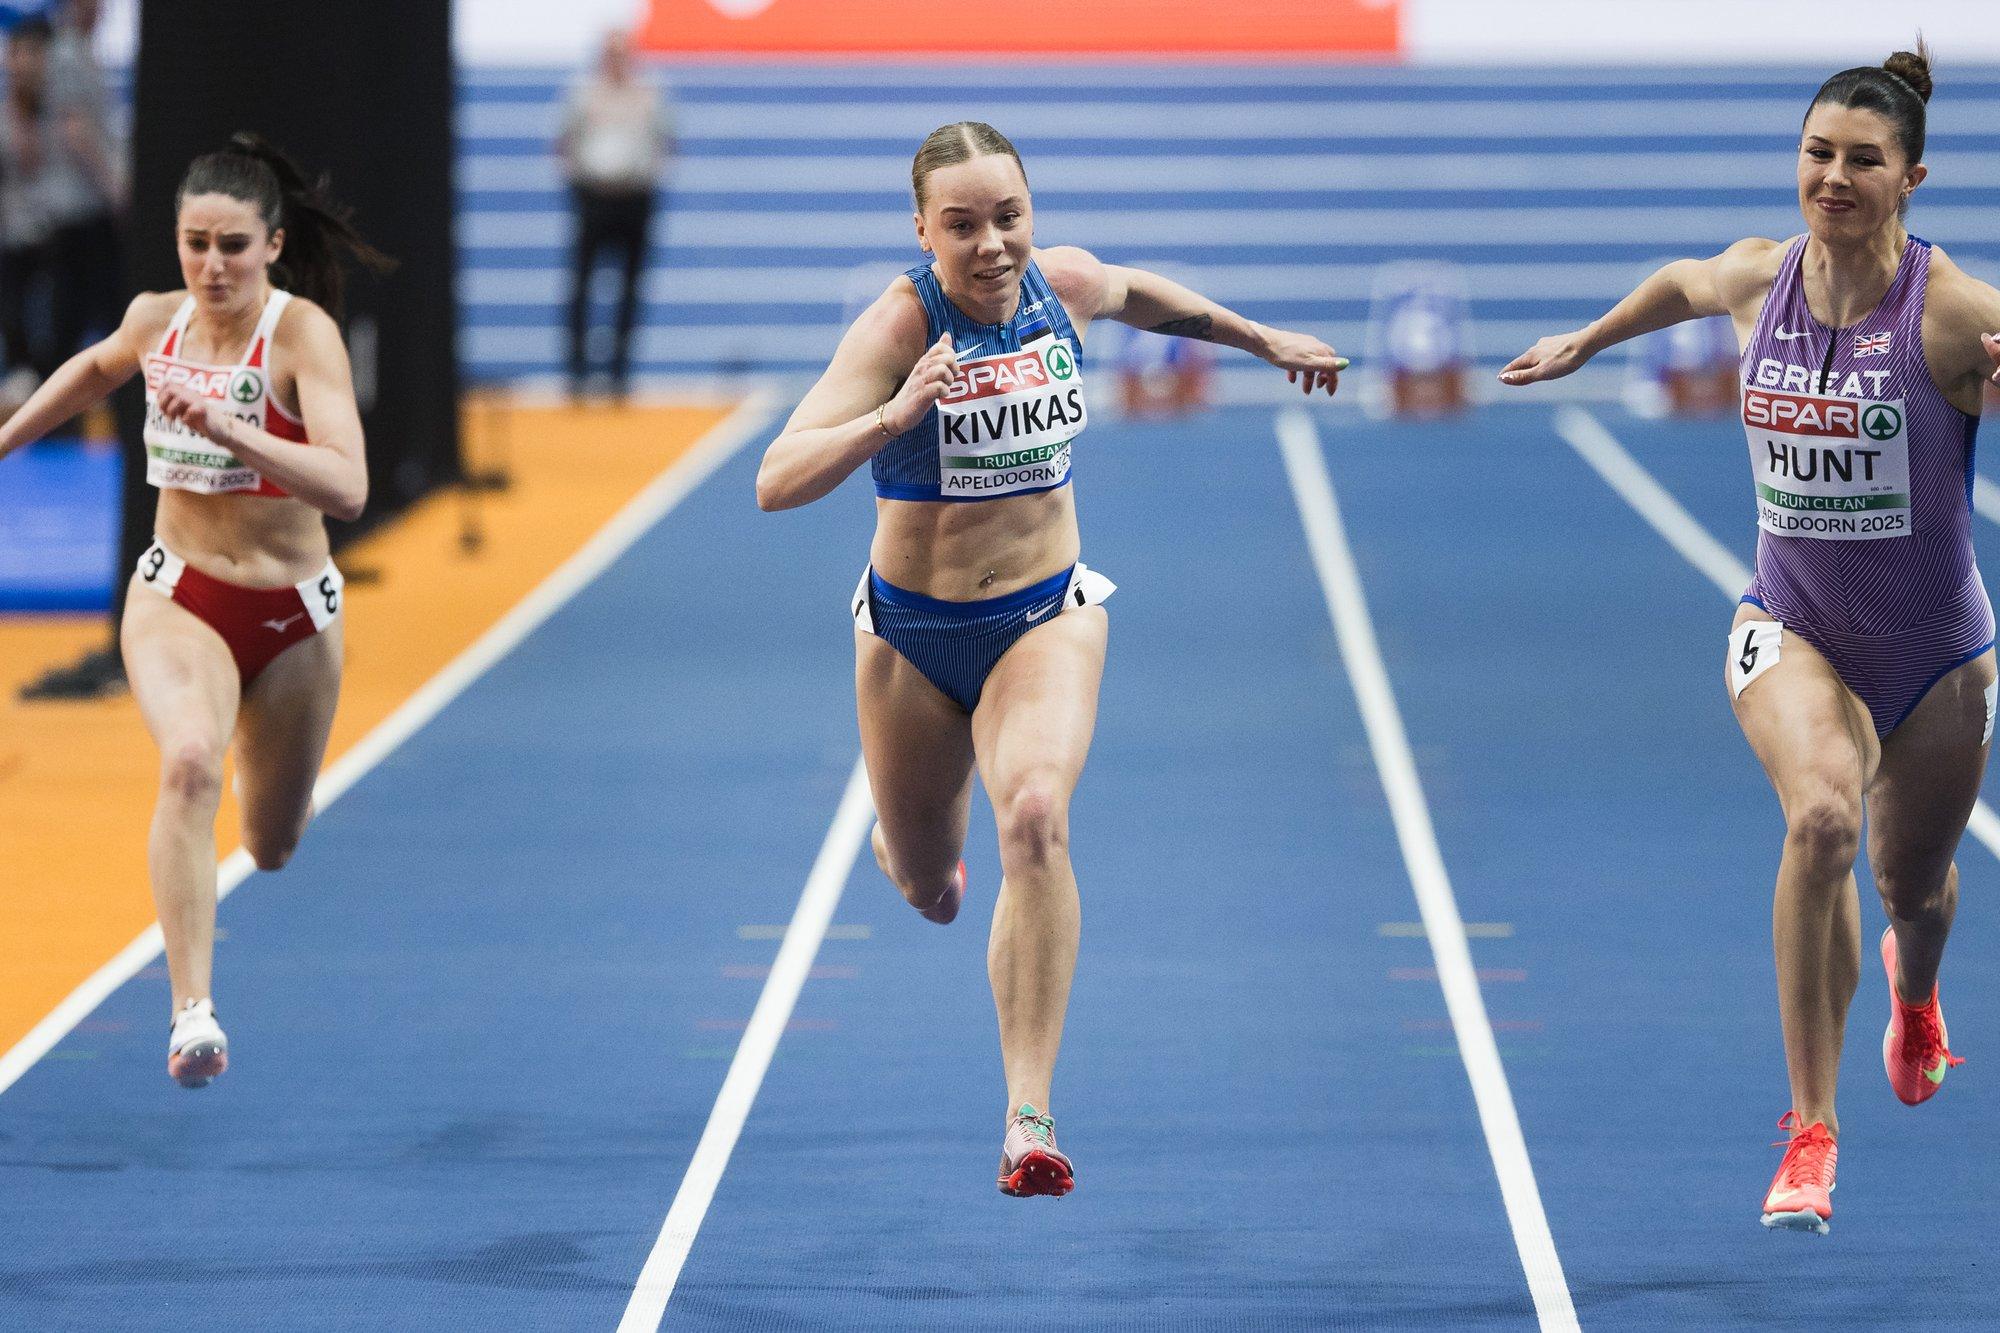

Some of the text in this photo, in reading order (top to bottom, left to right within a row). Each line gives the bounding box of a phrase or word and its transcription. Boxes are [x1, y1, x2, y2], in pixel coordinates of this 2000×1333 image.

[147, 361, 230, 399] SPAR
[948, 359, 1046, 399] SPAR
[1756, 358, 1891, 397] GREAT
[943, 388, 1083, 445] KIVIKAS
[1746, 396, 1855, 433] SPAR
[948, 466, 1056, 490] APELDOORN
[984, 454, 1018, 468] RUN
[1767, 440, 1882, 483] HUNT
[1779, 492, 1810, 509] RUN
[1761, 507, 1905, 533] APELDOORN 2025
[1739, 629, 1760, 675] 6
